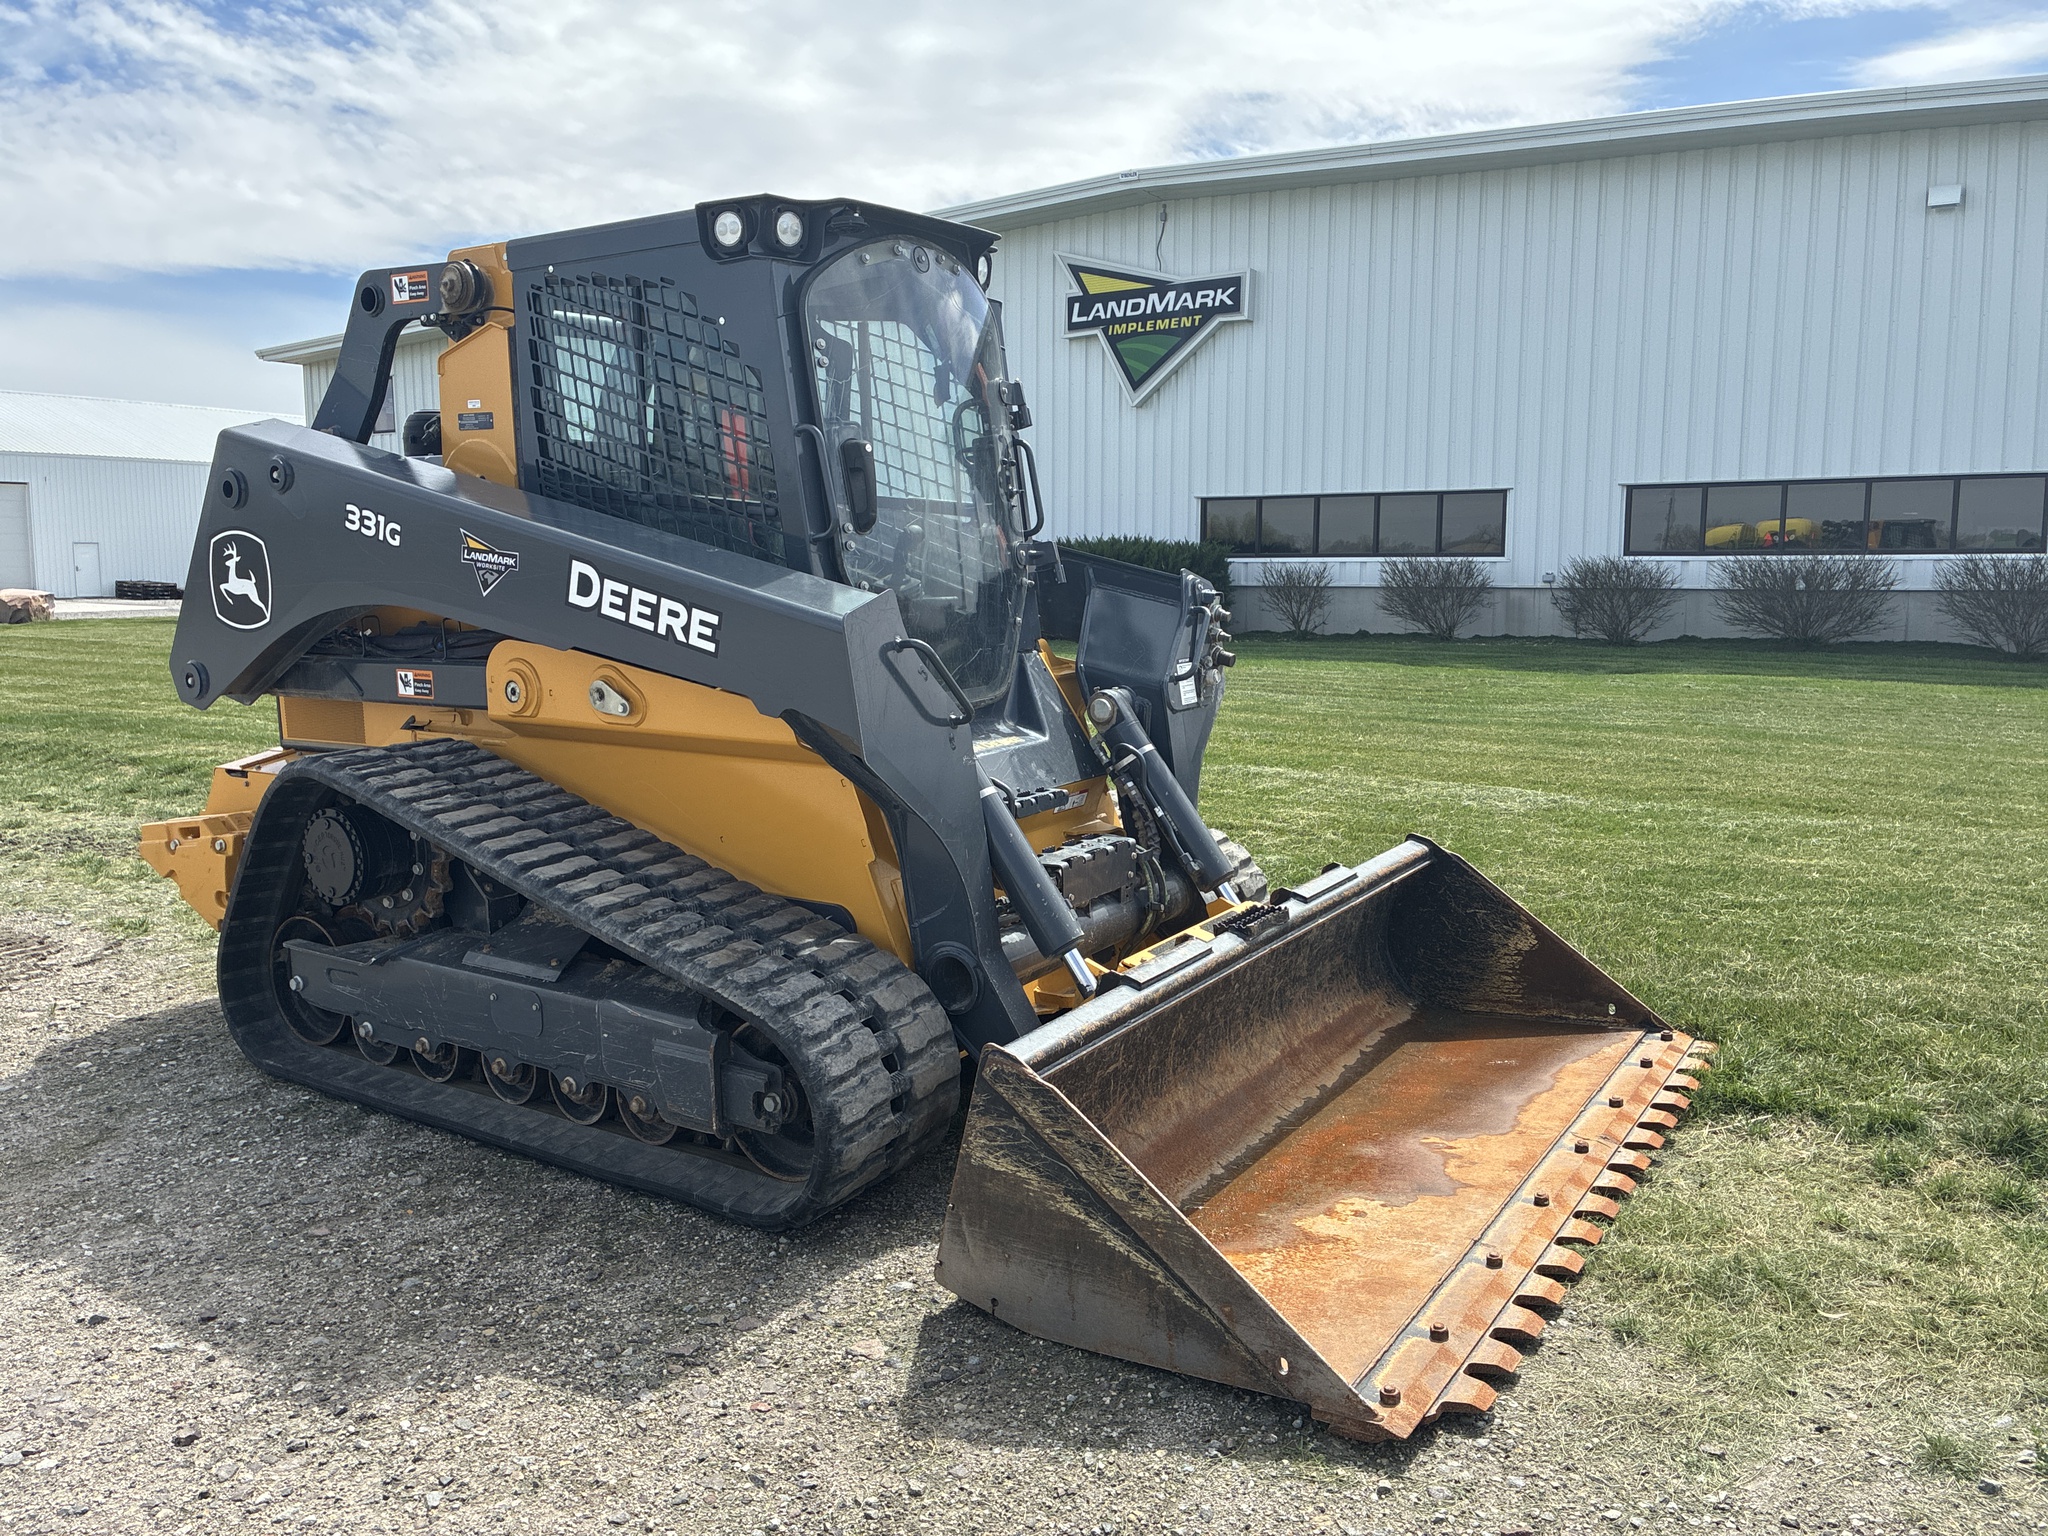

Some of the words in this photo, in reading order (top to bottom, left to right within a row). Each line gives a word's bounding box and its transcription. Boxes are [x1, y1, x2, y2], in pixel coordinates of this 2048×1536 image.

[1108, 314, 1203, 336] IMPLEMENT
[344, 502, 401, 547] 331G
[475, 562, 506, 572] WORKSITE
[567, 559, 720, 653] DEERE
